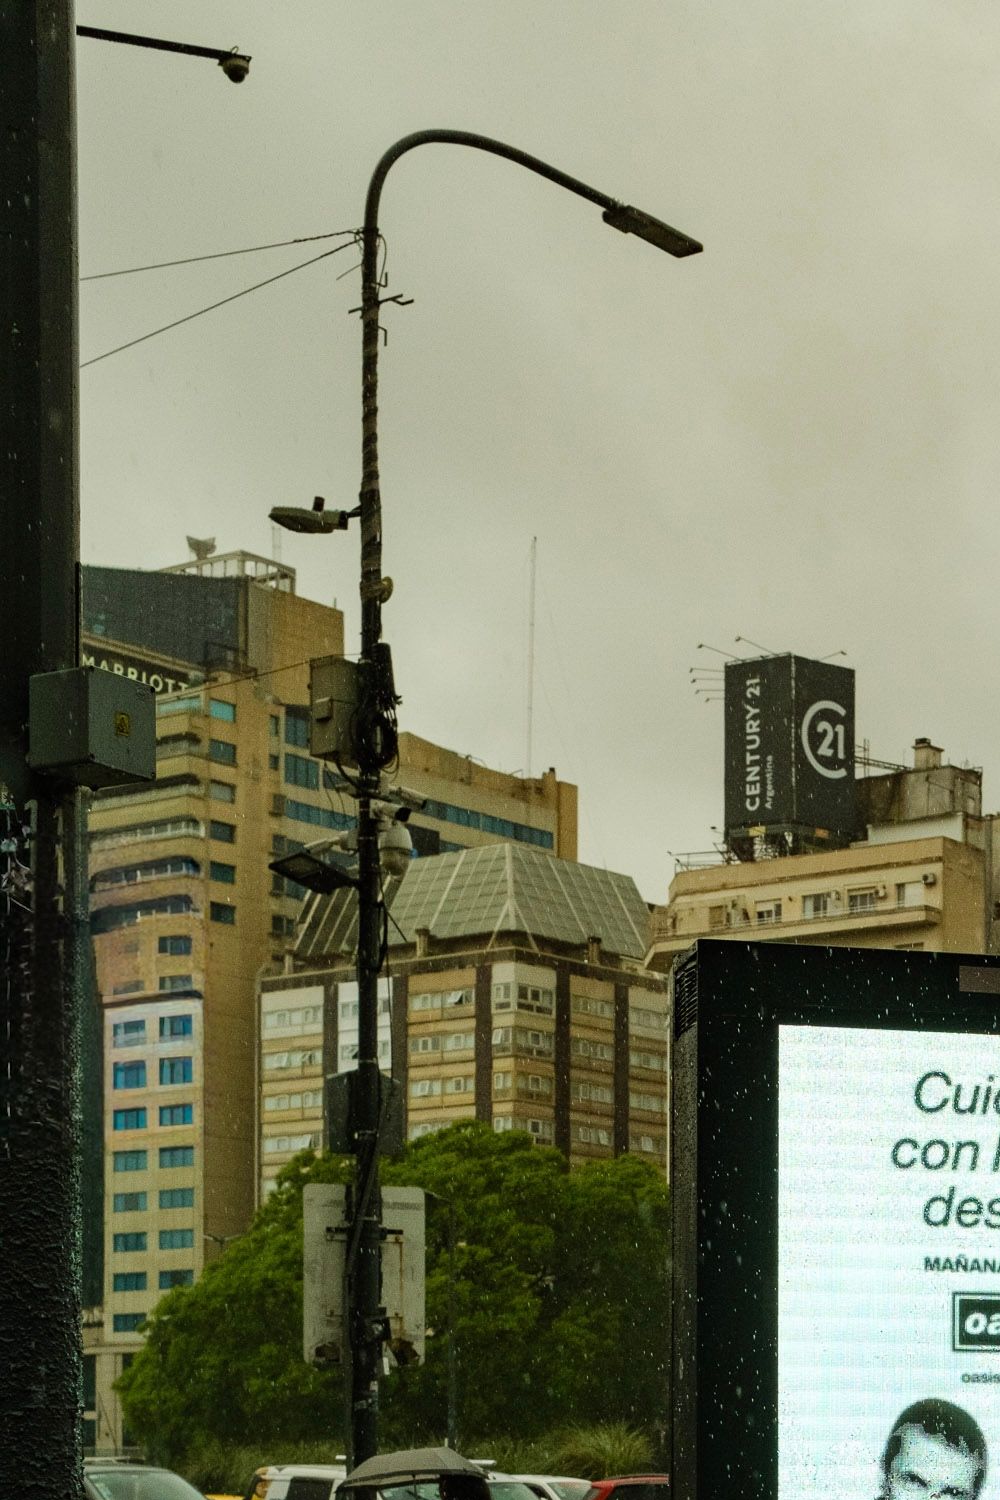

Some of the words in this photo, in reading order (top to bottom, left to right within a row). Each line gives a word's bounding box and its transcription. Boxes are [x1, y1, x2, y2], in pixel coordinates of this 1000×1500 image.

[745, 678, 761, 698] 21
[743, 701, 761, 811] CENTURY
[765, 755, 775, 810] Argentina
[891, 1137, 980, 1171] con
